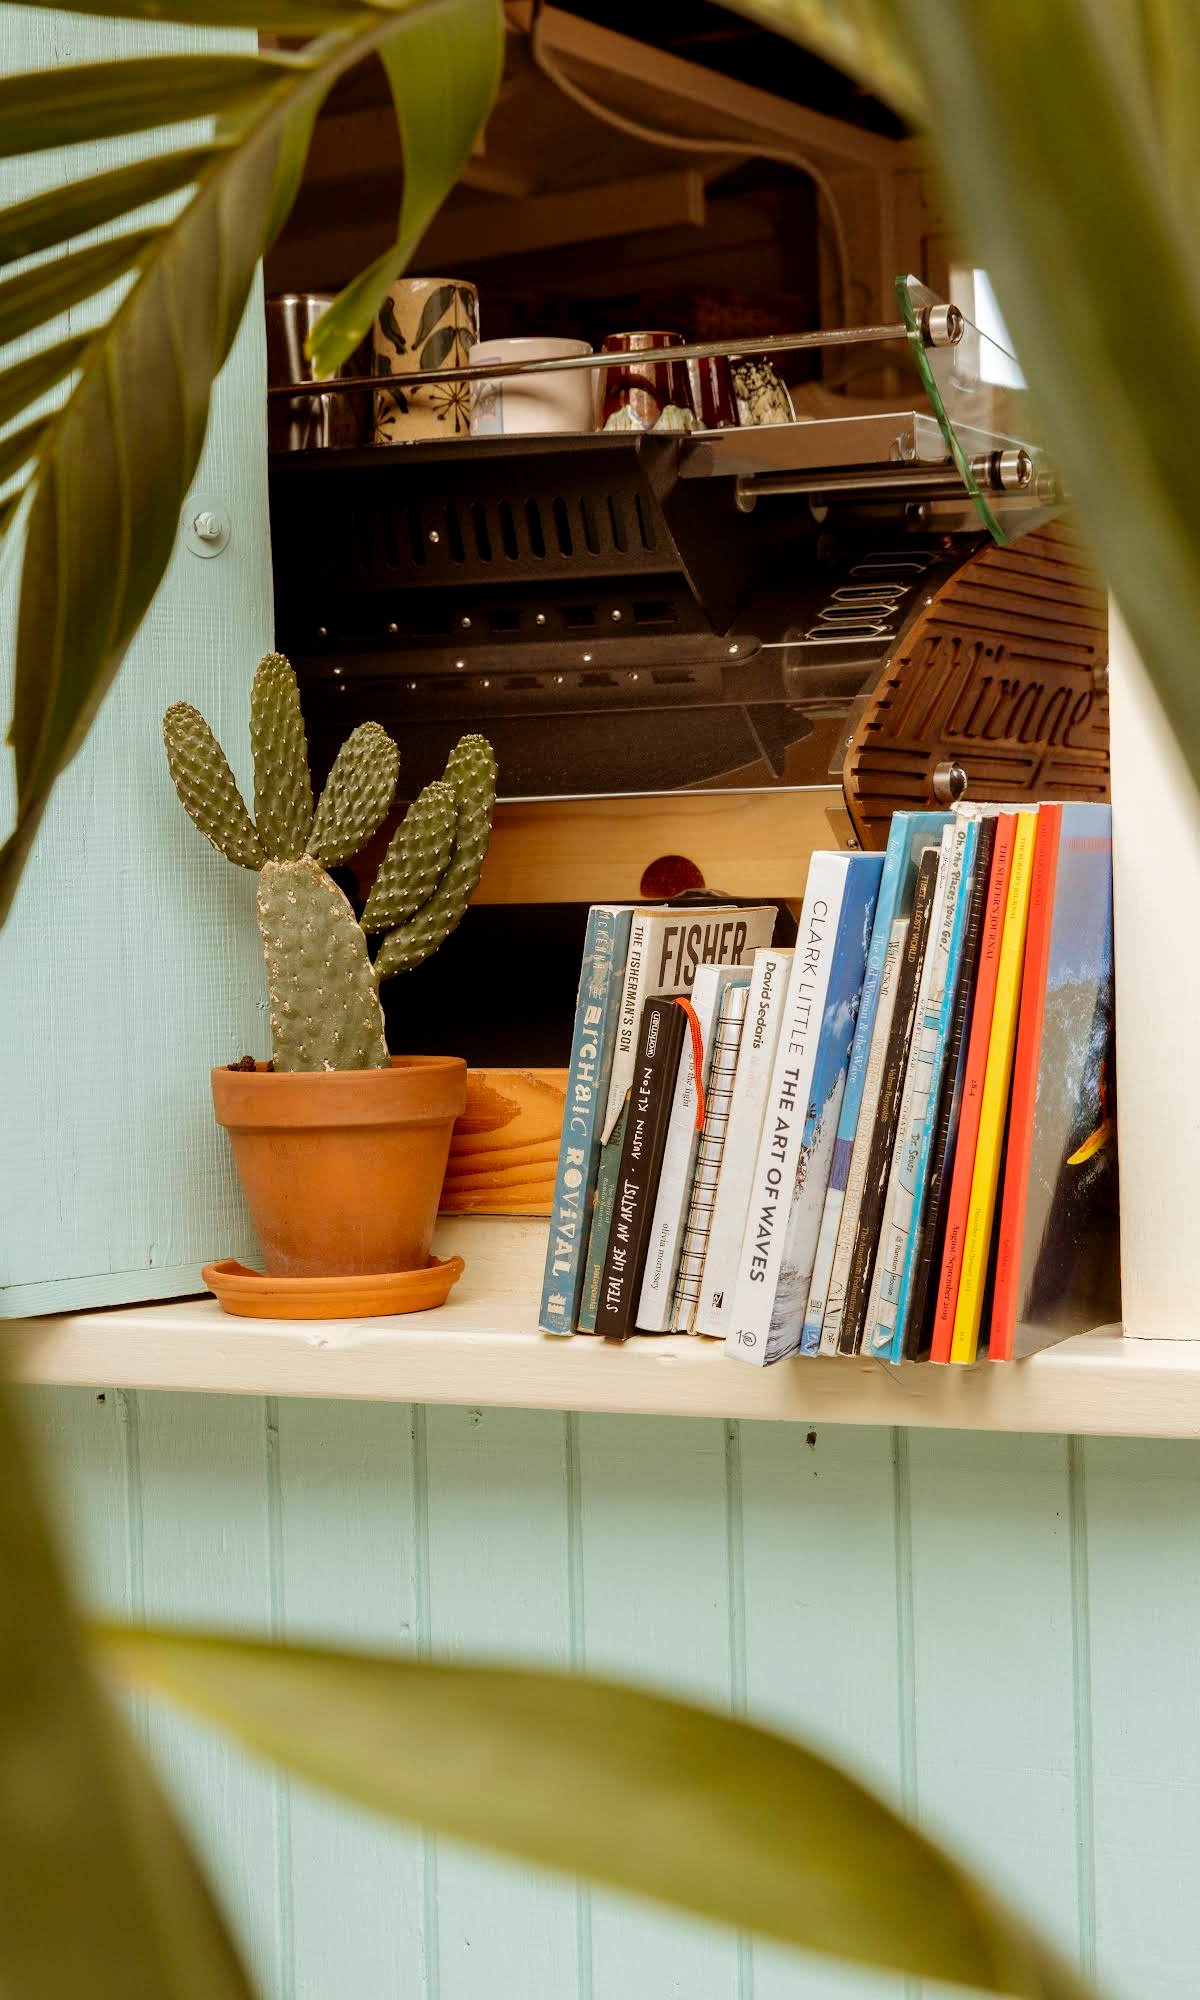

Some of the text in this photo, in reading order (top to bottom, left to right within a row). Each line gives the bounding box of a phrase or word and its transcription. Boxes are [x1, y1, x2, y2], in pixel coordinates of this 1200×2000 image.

[892, 635, 1094, 790] Mirage
[952, 851, 962, 867] the
[954, 830, 966, 849] Oh,
[946, 870, 960, 900] Places
[984, 843, 1007, 960] THE SURFER'S JOURNAL
[912, 910, 923, 931] LOST
[942, 903, 955, 927] You'll
[907, 932, 919, 962] WORLD
[938, 930, 952, 953] Go!
[619, 925, 644, 1052] THE FISHERMAN'S SON
[759, 961, 776, 999] David
[880, 940, 899, 996] Watterson
[752, 1001, 769, 1049] Sedaris
[848, 932, 884, 1084] The Old Woman & the Wave
[646, 1012, 660, 1055] workman
[681, 1087, 693, 1108] light
[685, 1072, 695, 1086] the
[748, 899, 829, 1282] CLARK LITTLE THE ART OF WAVES
[968, 1079, 977, 1096] 28.4
[630, 1066, 654, 1159] AUSTIN KLEON
[879, 1090, 892, 1122] Reynolds
[906, 1133, 919, 1172] Dr. Seuss
[604, 1178, 640, 1313] STEAL LIKE AN ARTIST
[650, 1223, 670, 1290] olivia morrissey
[587, 1264, 601, 1309] patagonia
[844, 1226, 869, 1335] The American Federation of Arts
[887, 1244, 901, 1295] Random House
[940, 1301, 949, 1320] 2019
